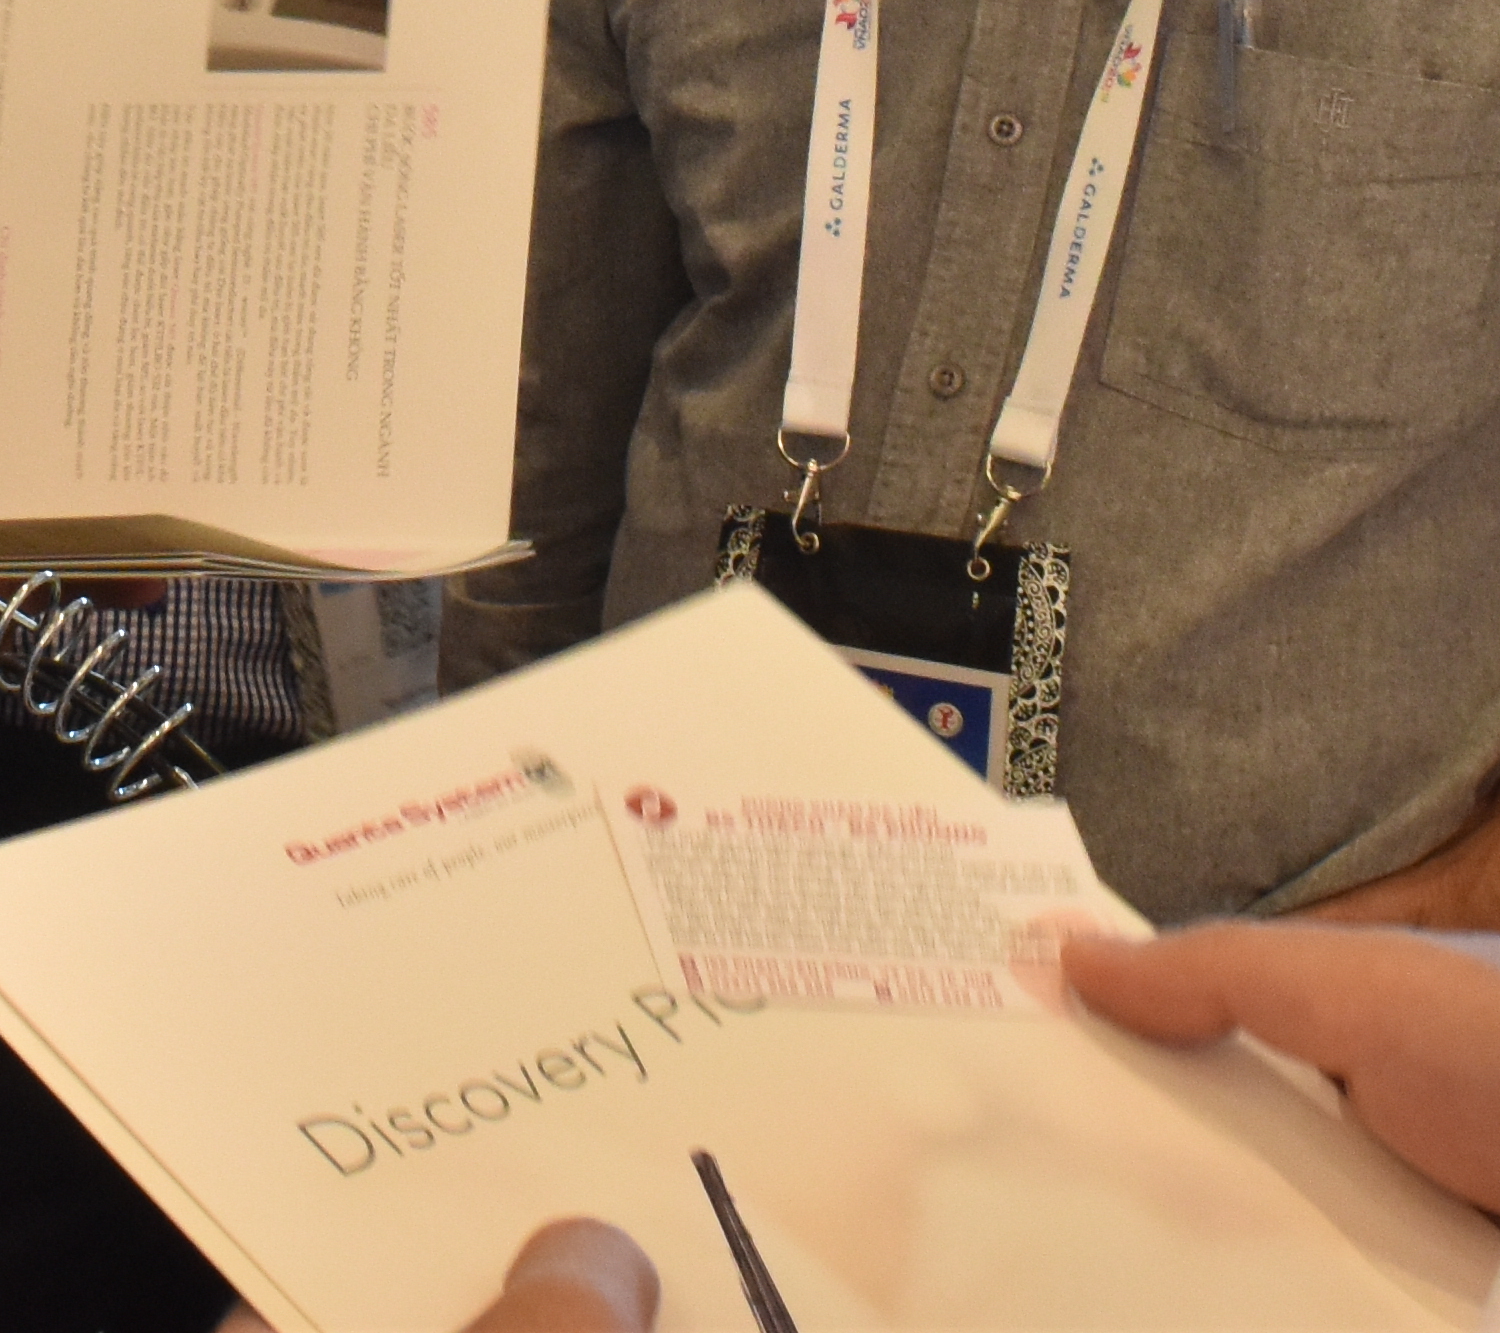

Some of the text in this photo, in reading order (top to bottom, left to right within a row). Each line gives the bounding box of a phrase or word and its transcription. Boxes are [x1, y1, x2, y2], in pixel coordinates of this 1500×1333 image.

[830, 97, 853, 212] GALDERMA
[1059, 183, 1097, 300] GALDERMA
[297, 1020, 649, 1177] Discovery
